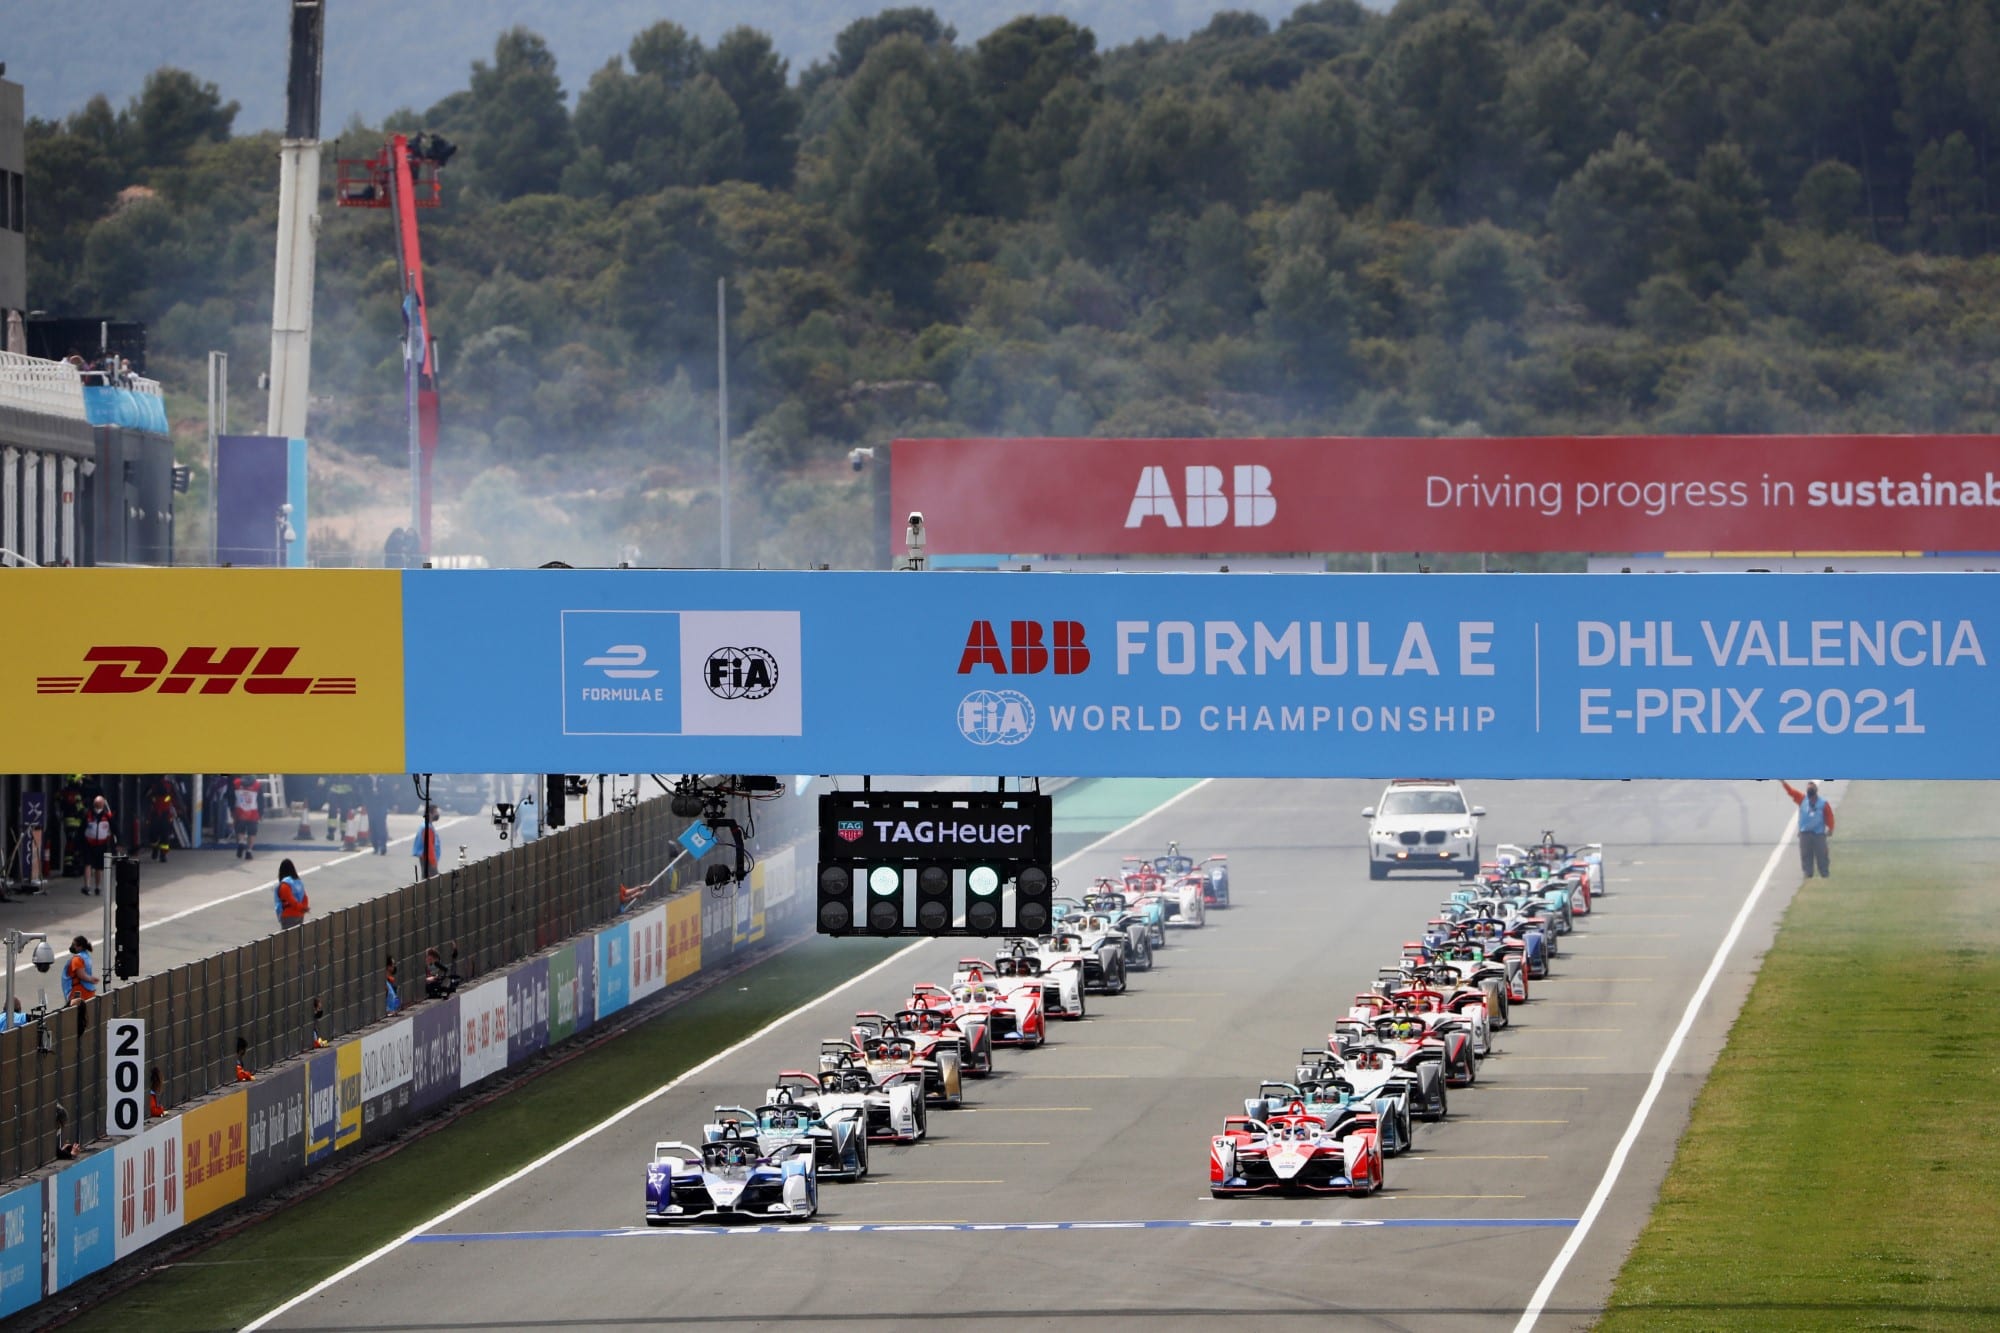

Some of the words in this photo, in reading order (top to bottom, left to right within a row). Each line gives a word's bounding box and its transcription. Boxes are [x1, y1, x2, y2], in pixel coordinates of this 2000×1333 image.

[1124, 464, 1277, 528] ABB
[1426, 473, 1562, 516] Driving
[1576, 480, 1748, 516] progress
[1762, 473, 1794, 507] in
[957, 620, 1091, 675] ABB
[1116, 620, 1440, 676] FORMULA
[1459, 621, 1495, 676] E
[1577, 620, 1693, 667] DHL
[1700, 619, 1987, 668] VALENCIA
[80, 646, 315, 694] DHL
[582, 687, 651, 701] FORMULA
[655, 688, 663, 701] E
[1049, 705, 1182, 732] WORLD
[1199, 705, 1496, 733] CHAMPIONSHIP
[1579, 687, 1766, 735] E-PRIX
[1778, 687, 1926, 735] 2021
